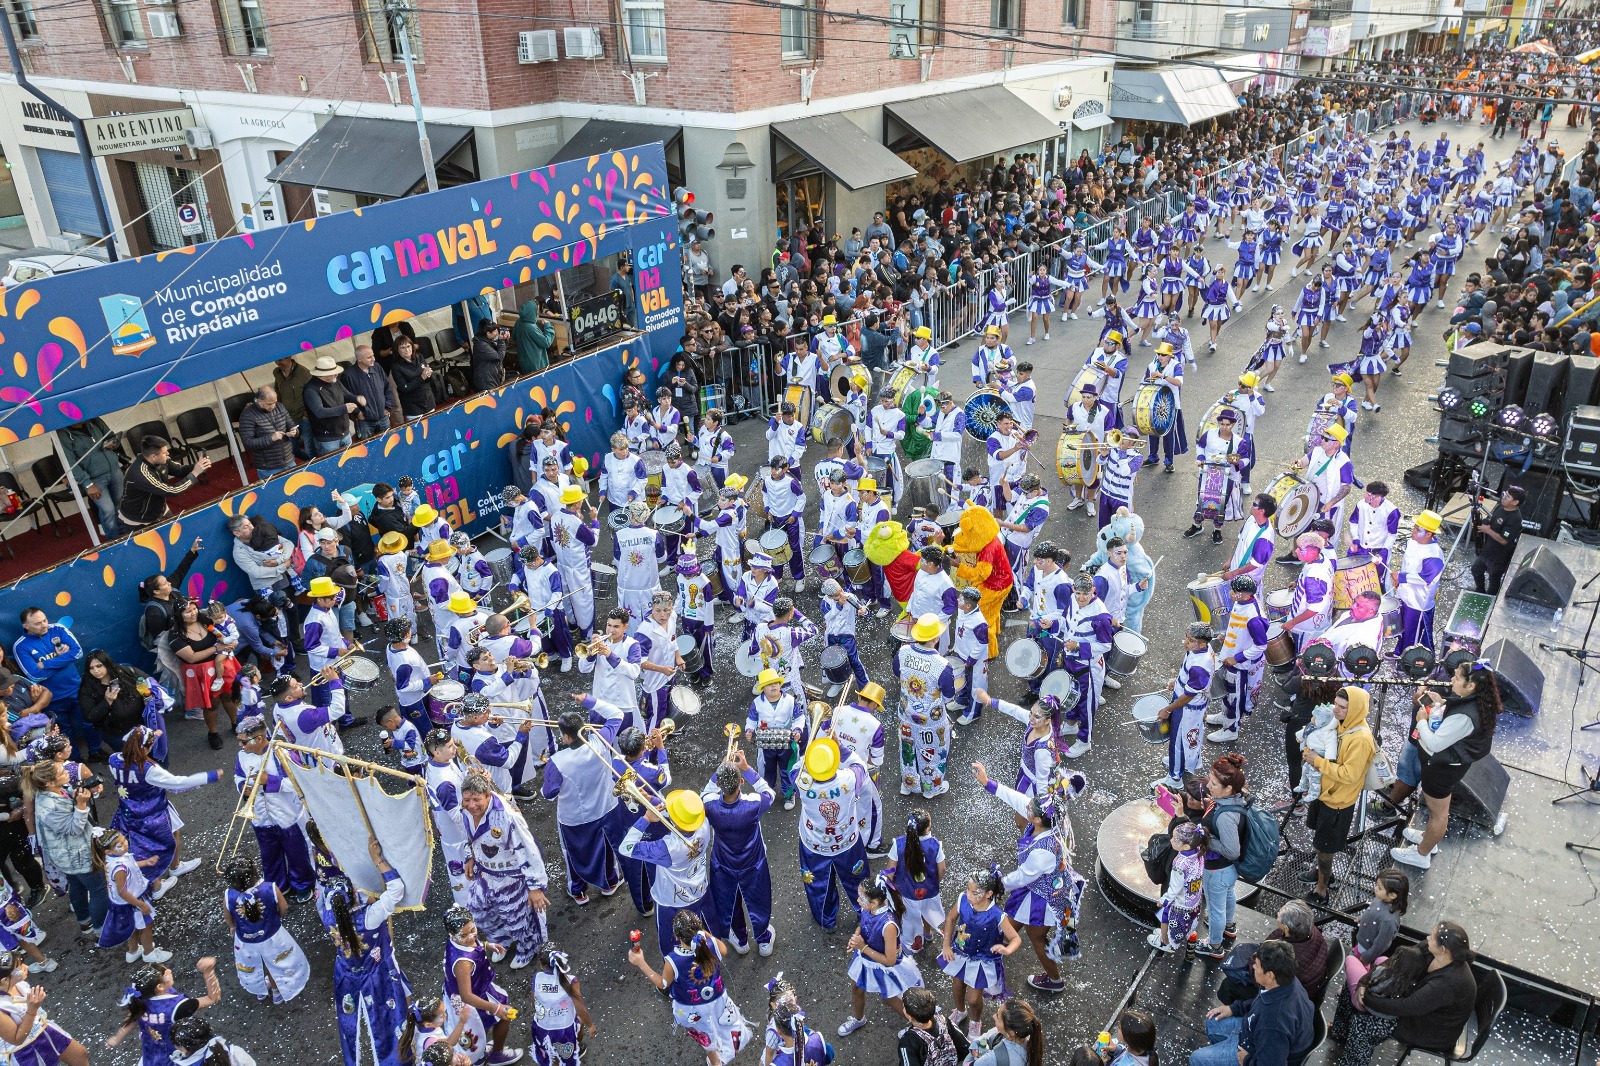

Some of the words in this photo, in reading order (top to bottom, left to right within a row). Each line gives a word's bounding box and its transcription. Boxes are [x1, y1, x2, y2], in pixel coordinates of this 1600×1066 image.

[96, 115, 182, 140] ARGENTINO
[240, 117, 249, 125] LA
[251, 119, 286, 129] AGRICOLA
[97, 140, 147, 151] INDUMENTARIA
[151, 135, 186, 144] MASCULIN
[183, 208, 193, 220] E
[155, 259, 283, 306] Municipalidad
[161, 307, 186, 325] de
[190, 282, 287, 317] Comodoro
[574, 304, 618, 333] 04:46
[645, 306, 681, 324] Comodoro
[166, 307, 259, 345] Rivadavia
[645, 316, 679, 333] Rivadavia
[620, 536, 653, 548] WILLIAMS
[919, 730, 934, 745] 10
[805, 783, 850, 799] DANI
